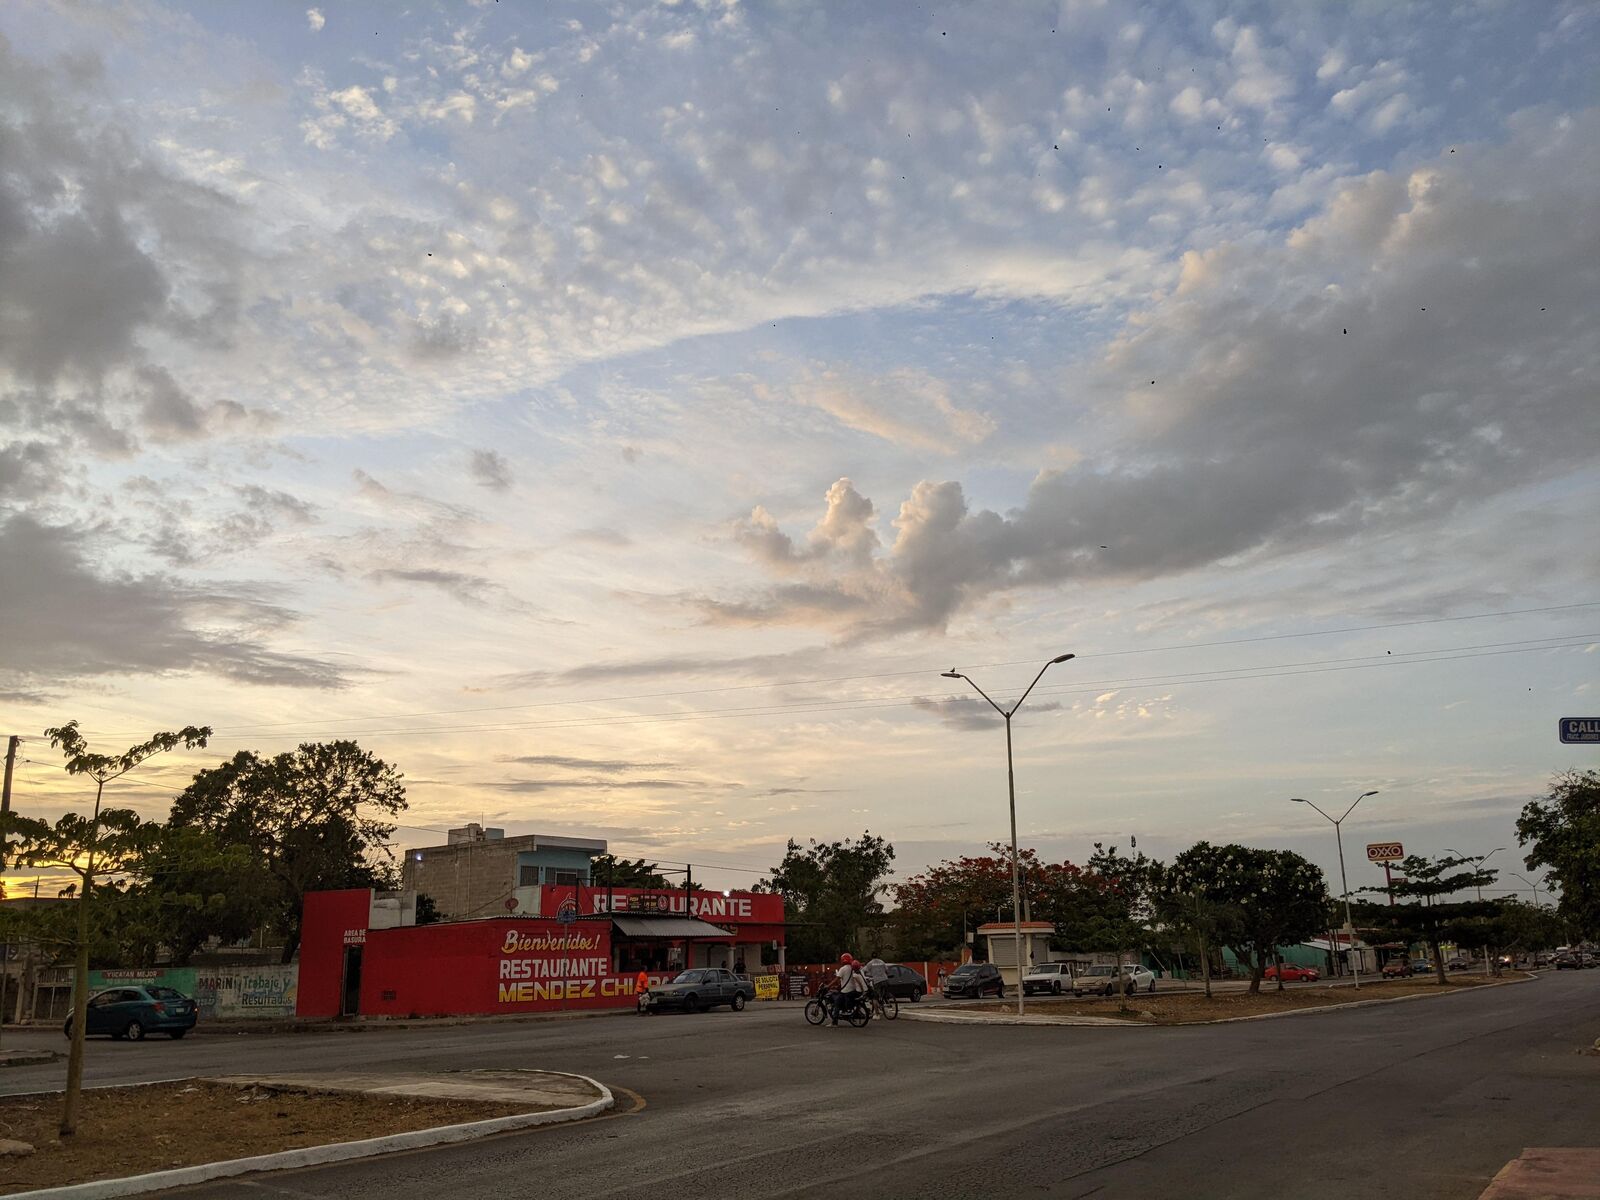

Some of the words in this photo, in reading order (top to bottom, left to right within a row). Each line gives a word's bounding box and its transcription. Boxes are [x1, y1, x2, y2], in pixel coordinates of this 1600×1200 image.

[1368, 846, 1401, 857] OXXO
[594, 894, 751, 917] REURANTE
[343, 936, 366, 944] BASURA
[359, 928, 367, 936] DE
[499, 957, 607, 979] RESTAURANTE
[498, 979, 596, 1003] MENDEZ
